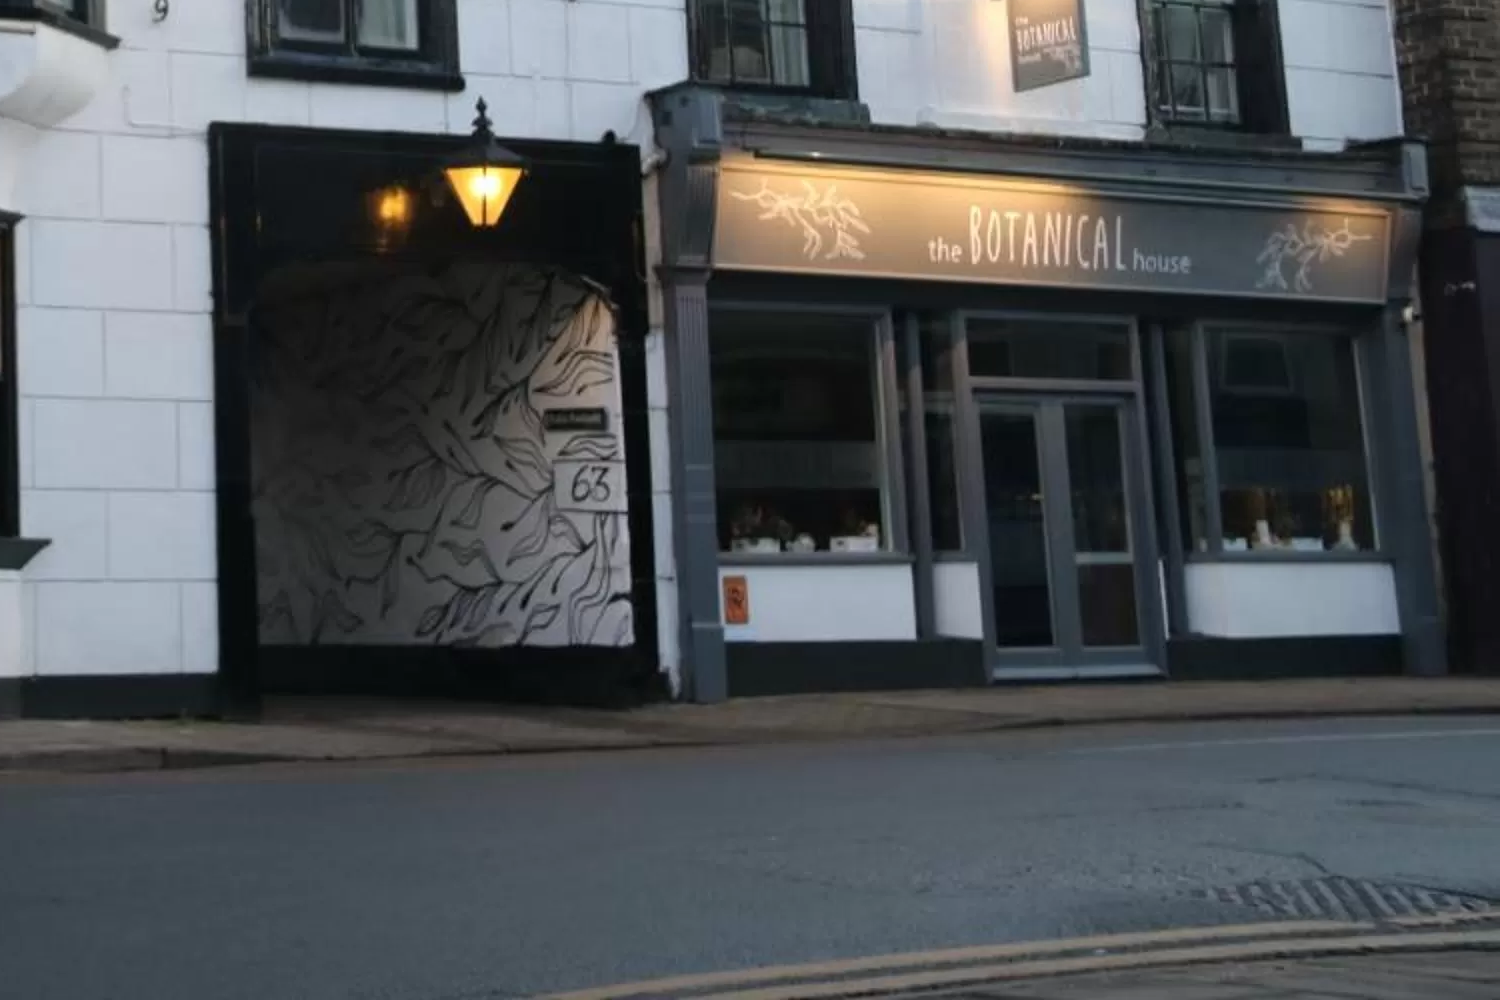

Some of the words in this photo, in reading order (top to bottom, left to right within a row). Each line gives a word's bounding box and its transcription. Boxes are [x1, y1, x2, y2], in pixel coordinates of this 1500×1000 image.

[928, 236, 962, 263] the
[969, 205, 1127, 271] BOTANICAL
[1132, 248, 1192, 274] house
[571, 464, 611, 502] 63
